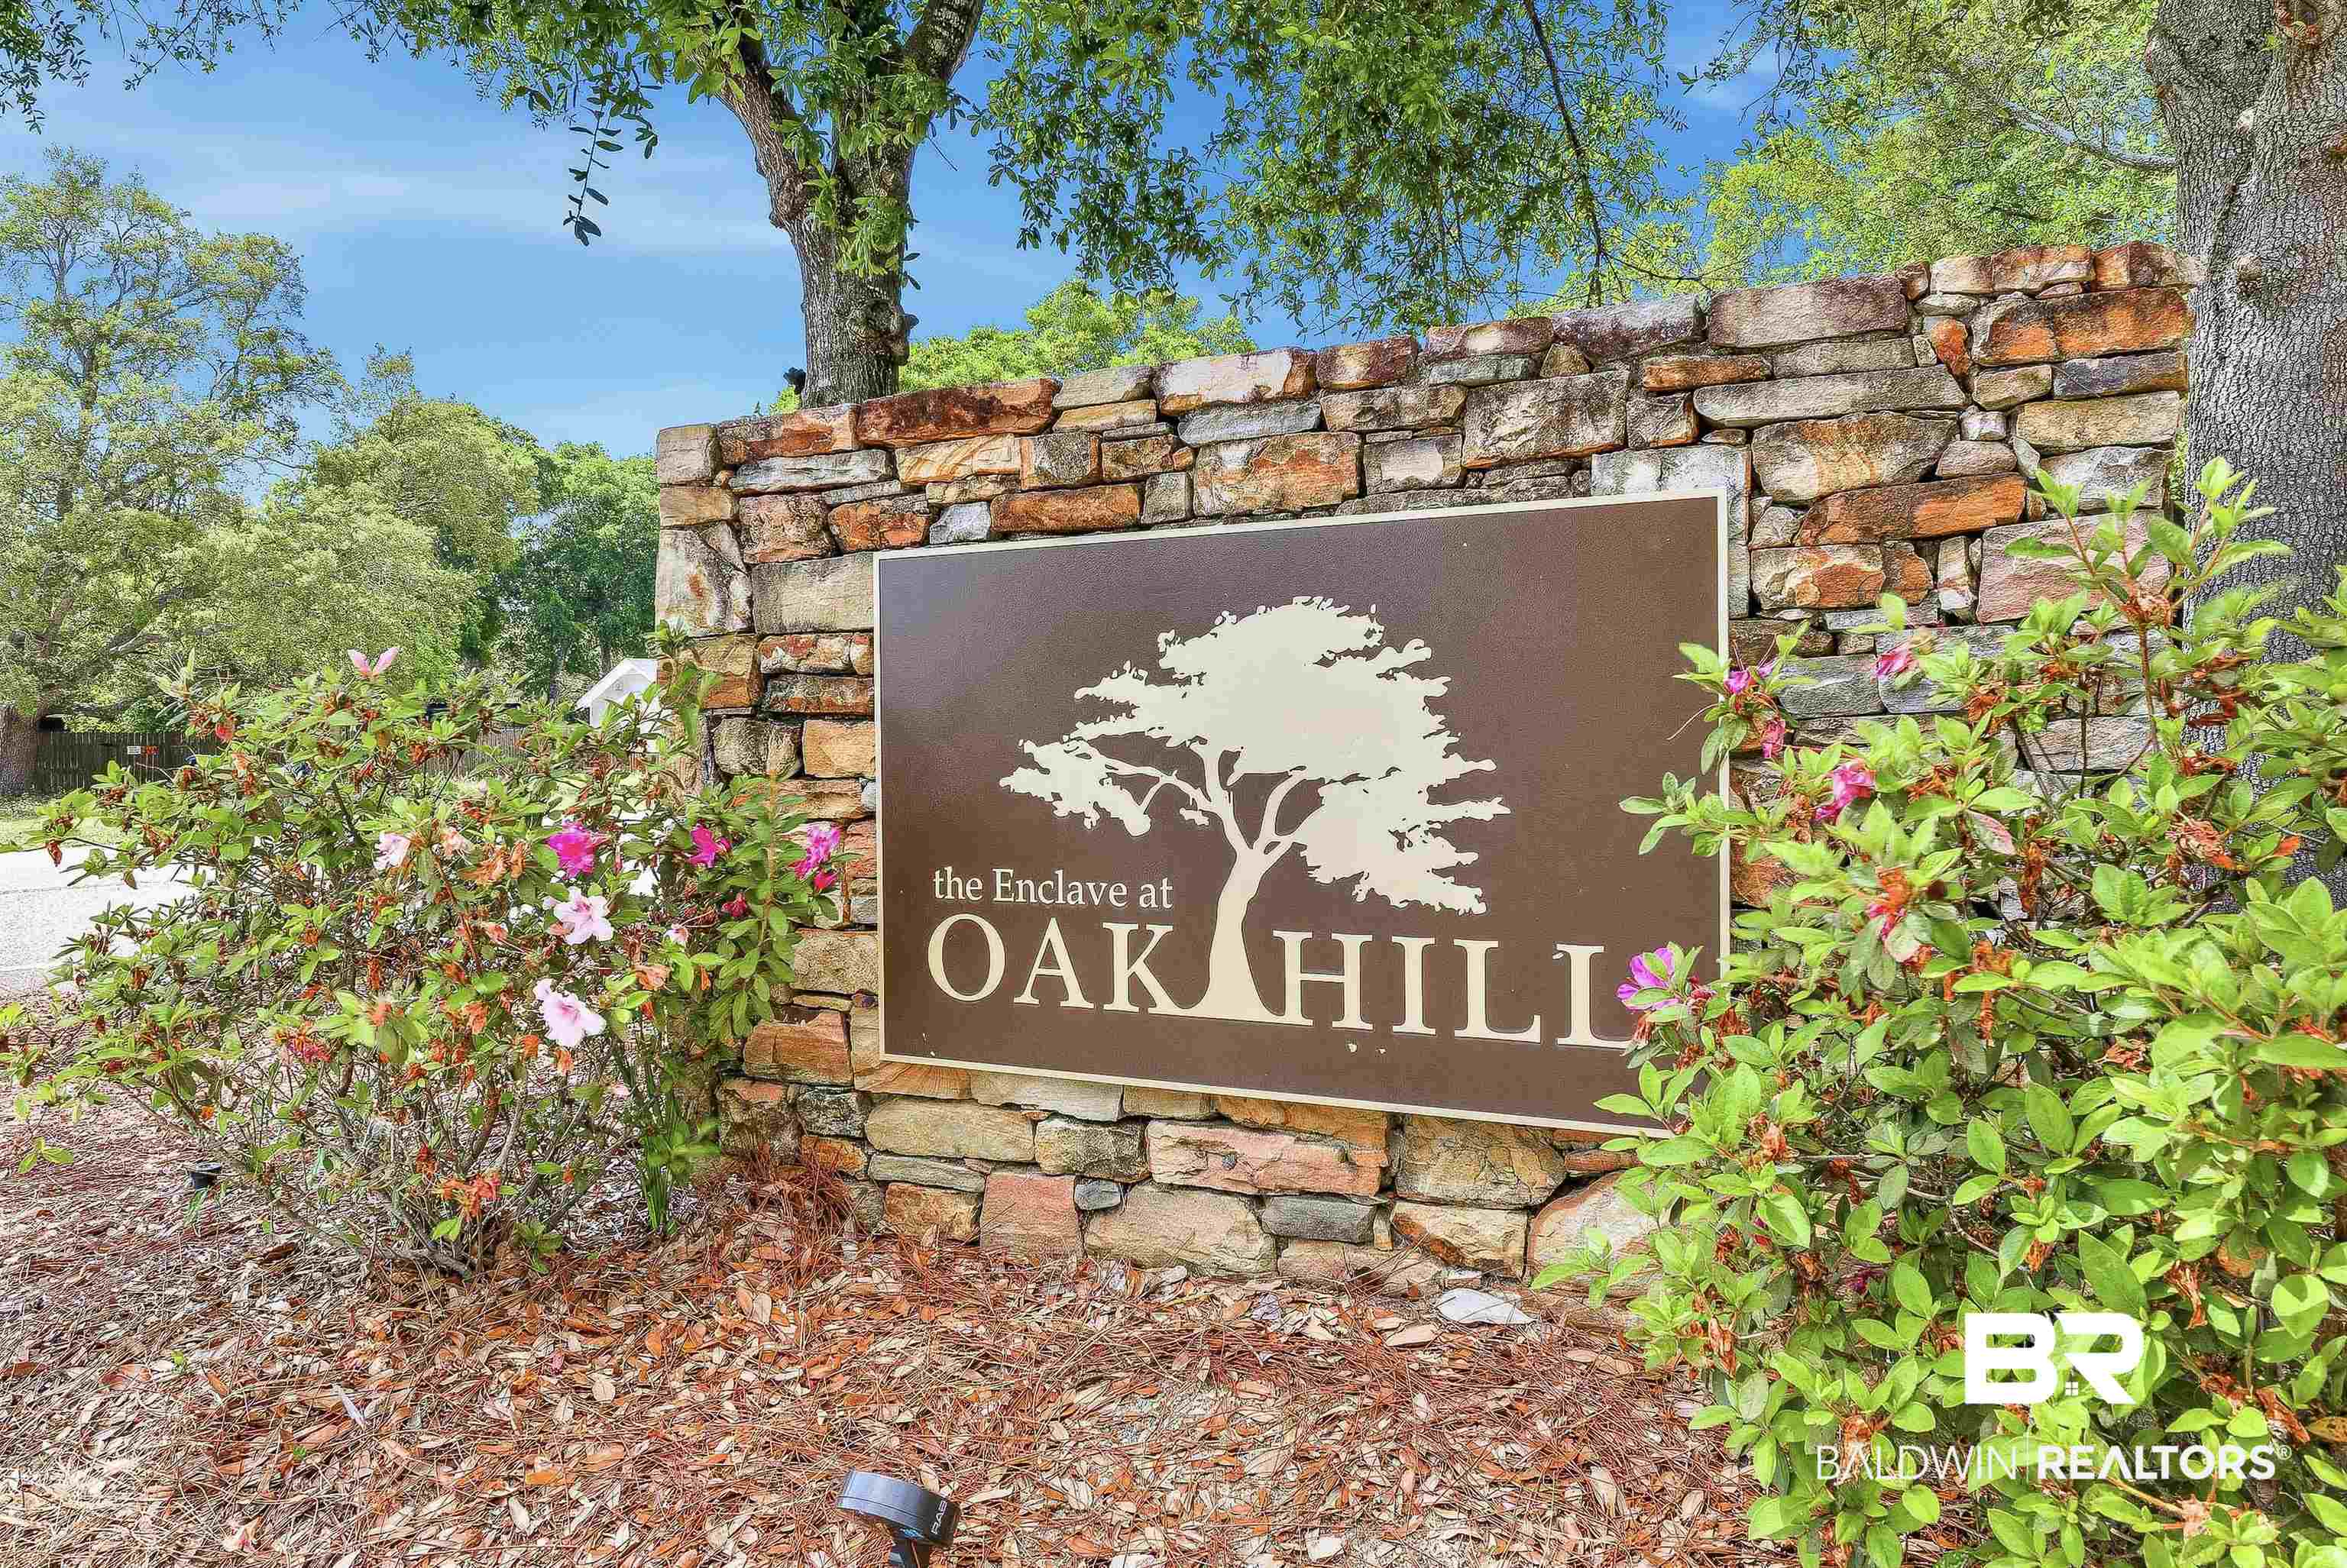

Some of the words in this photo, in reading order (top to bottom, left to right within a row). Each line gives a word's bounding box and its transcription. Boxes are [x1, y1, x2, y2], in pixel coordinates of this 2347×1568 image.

[933, 866, 983, 901] the
[992, 868, 1128, 907] Enclave
[1138, 877, 1174, 908] at
[927, 913, 1189, 1014] OAK
[1273, 929, 1633, 1049] HILL
[931, 1500, 947, 1534] RAB
